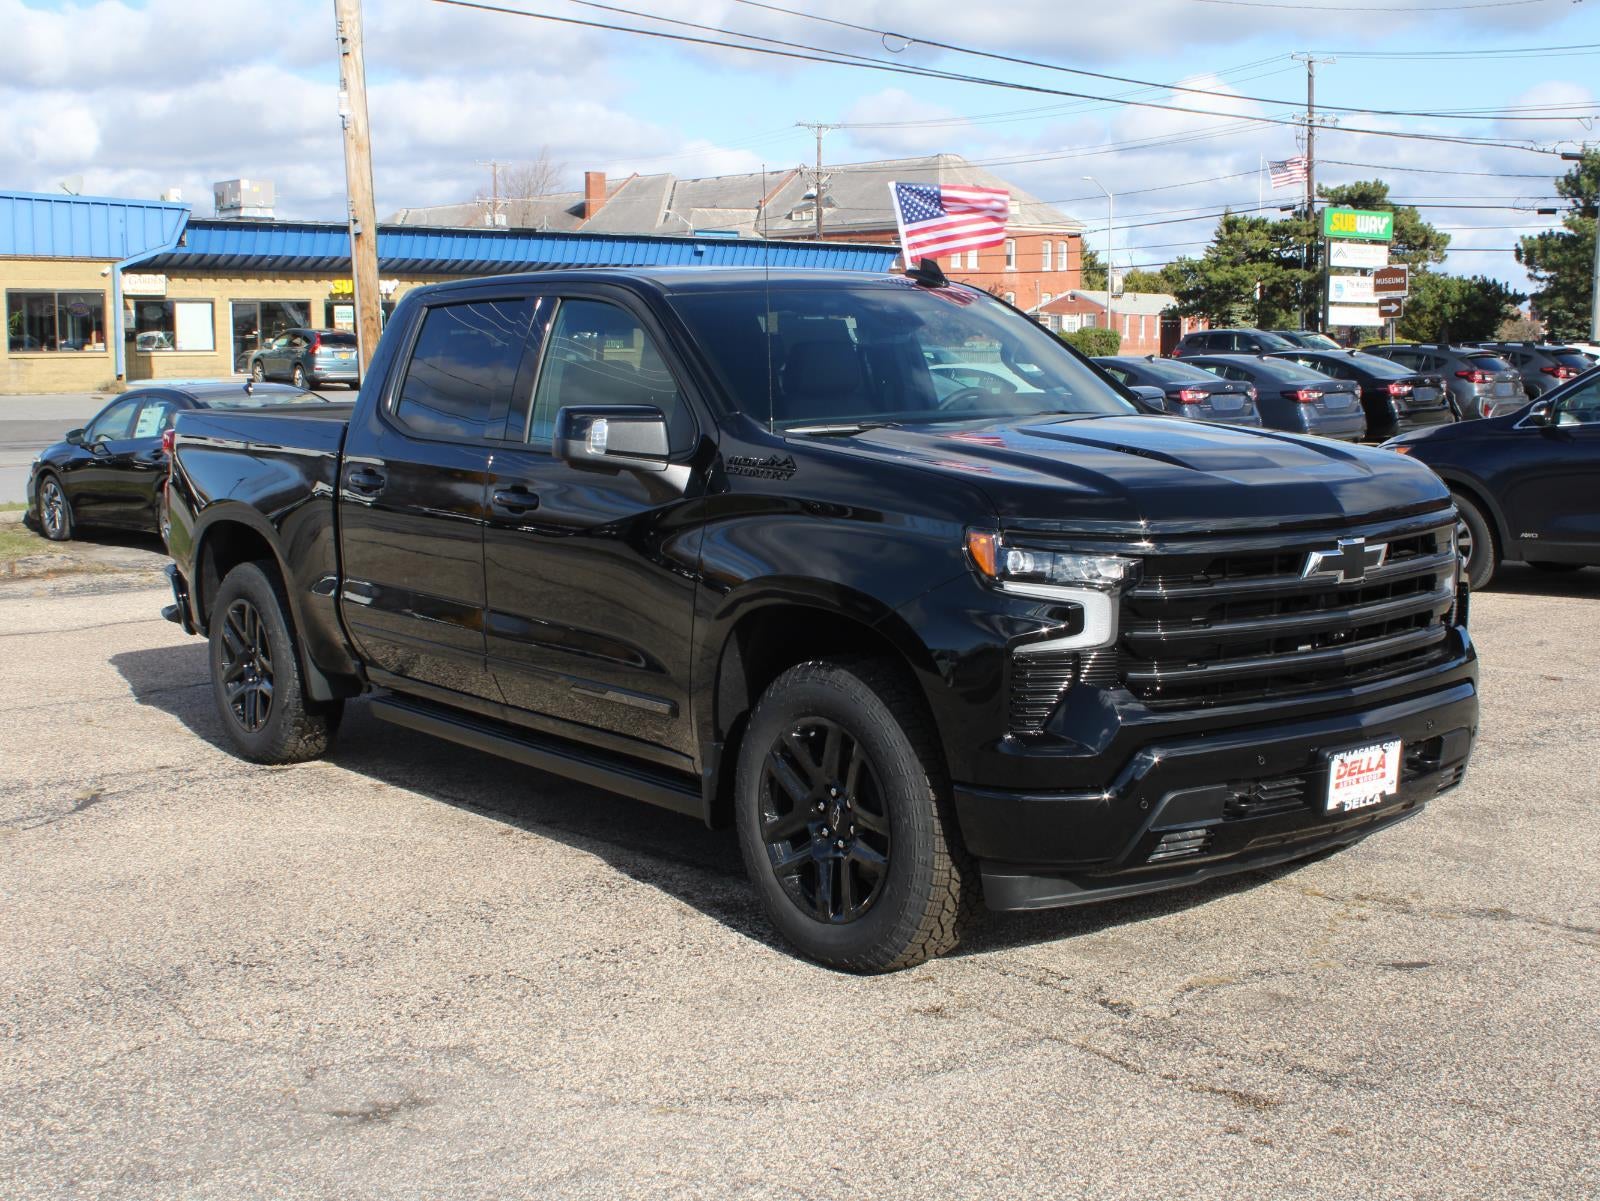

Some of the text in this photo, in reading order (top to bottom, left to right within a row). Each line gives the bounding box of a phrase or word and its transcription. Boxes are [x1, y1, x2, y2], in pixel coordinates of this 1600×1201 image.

[1330, 212, 1390, 235] SUBWAY
[1375, 276, 1405, 285] MUSEUMS
[1335, 753, 1386, 780] DELLA
[1344, 793, 1381, 812] DELLA
